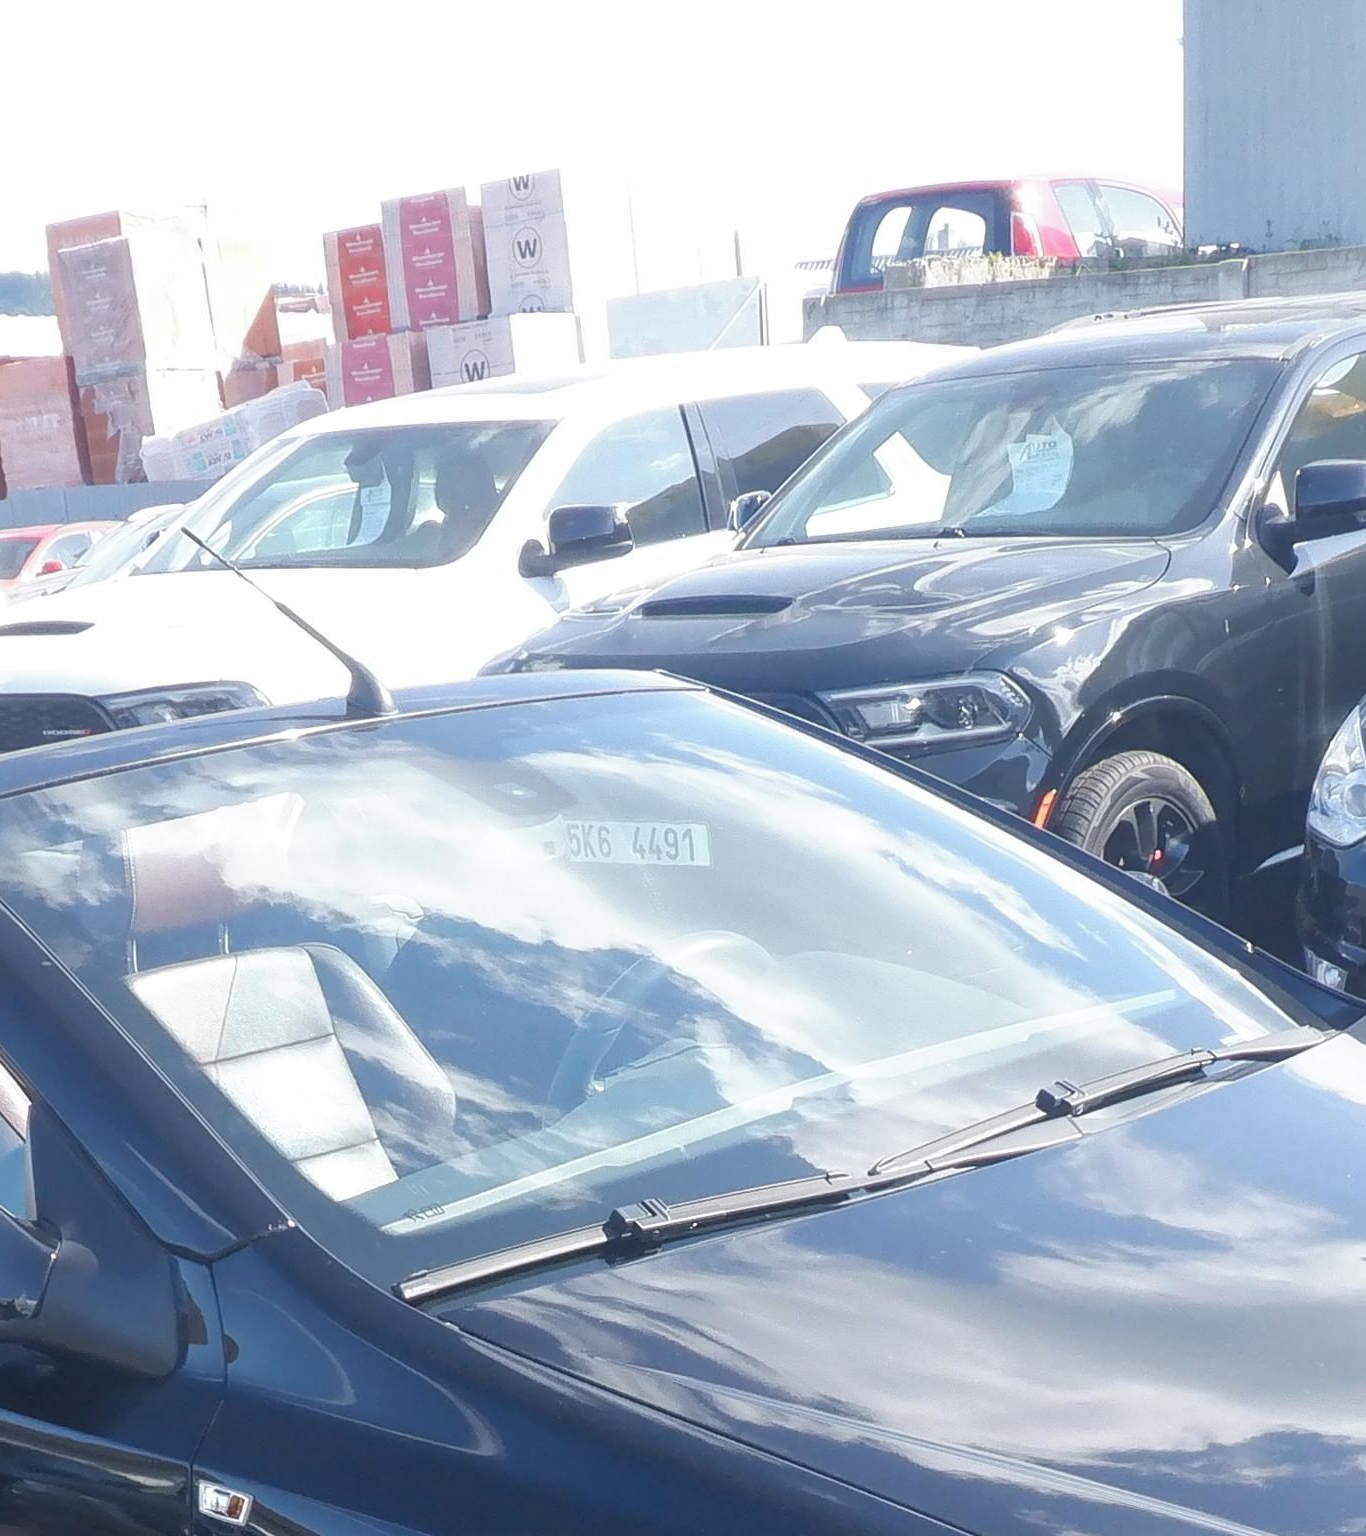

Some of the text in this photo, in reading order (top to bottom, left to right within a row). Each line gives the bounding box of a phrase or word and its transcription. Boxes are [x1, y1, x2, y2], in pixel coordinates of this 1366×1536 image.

[513, 174, 530, 191] W
[516, 238, 537, 259] W
[464, 361, 485, 382] W
[566, 823, 696, 862] 5K6 4491
